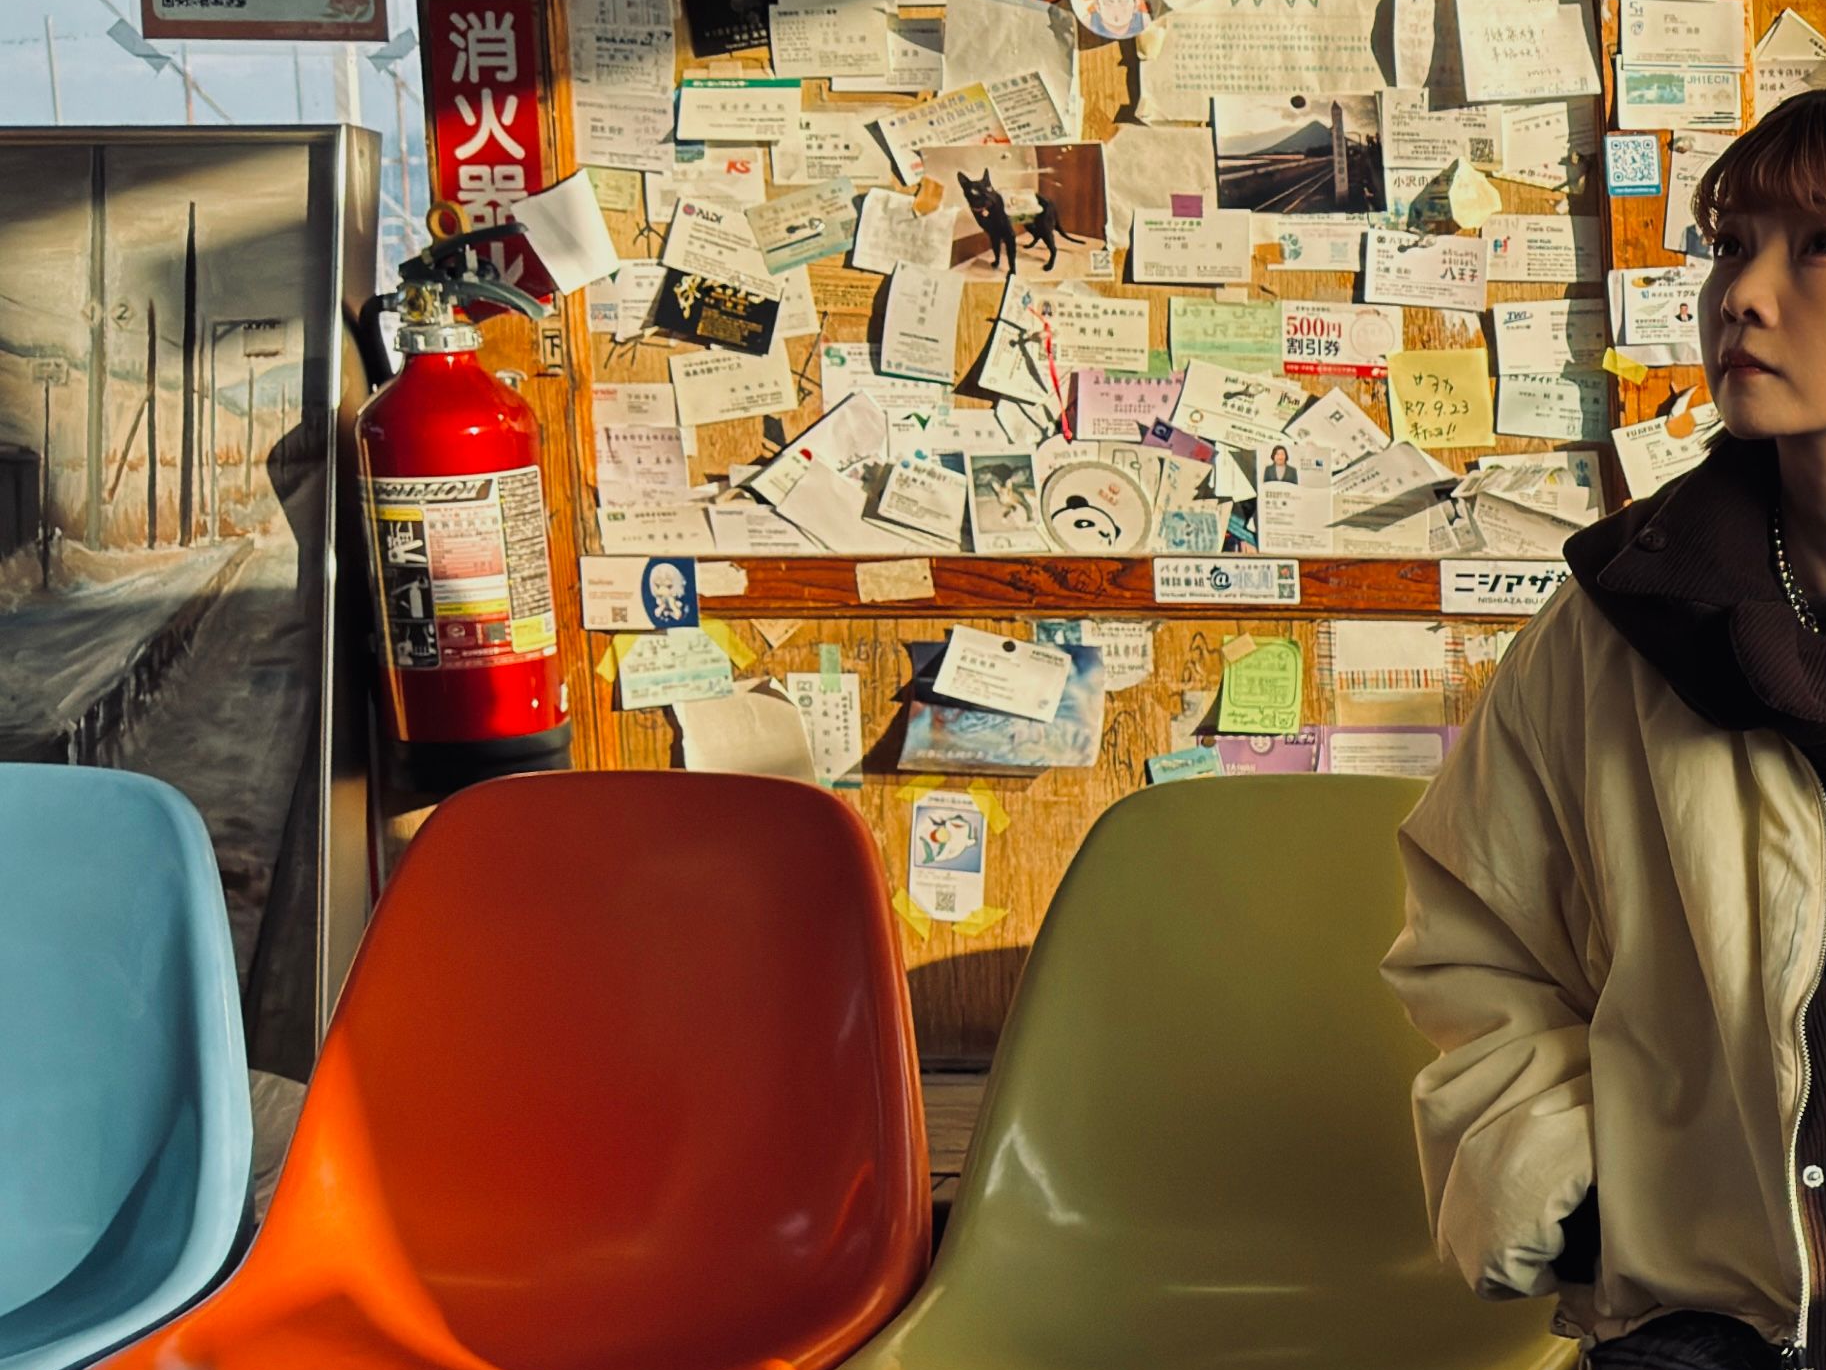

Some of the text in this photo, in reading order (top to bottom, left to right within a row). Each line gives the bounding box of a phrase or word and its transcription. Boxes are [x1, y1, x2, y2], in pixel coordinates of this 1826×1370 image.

[449, 10, 527, 228] 消火器
[726, 159, 753, 177] KS
[1439, 267, 1479, 282] 八王子
[1285, 315, 1342, 339] 500円
[1285, 338, 1341, 357] 割引券
